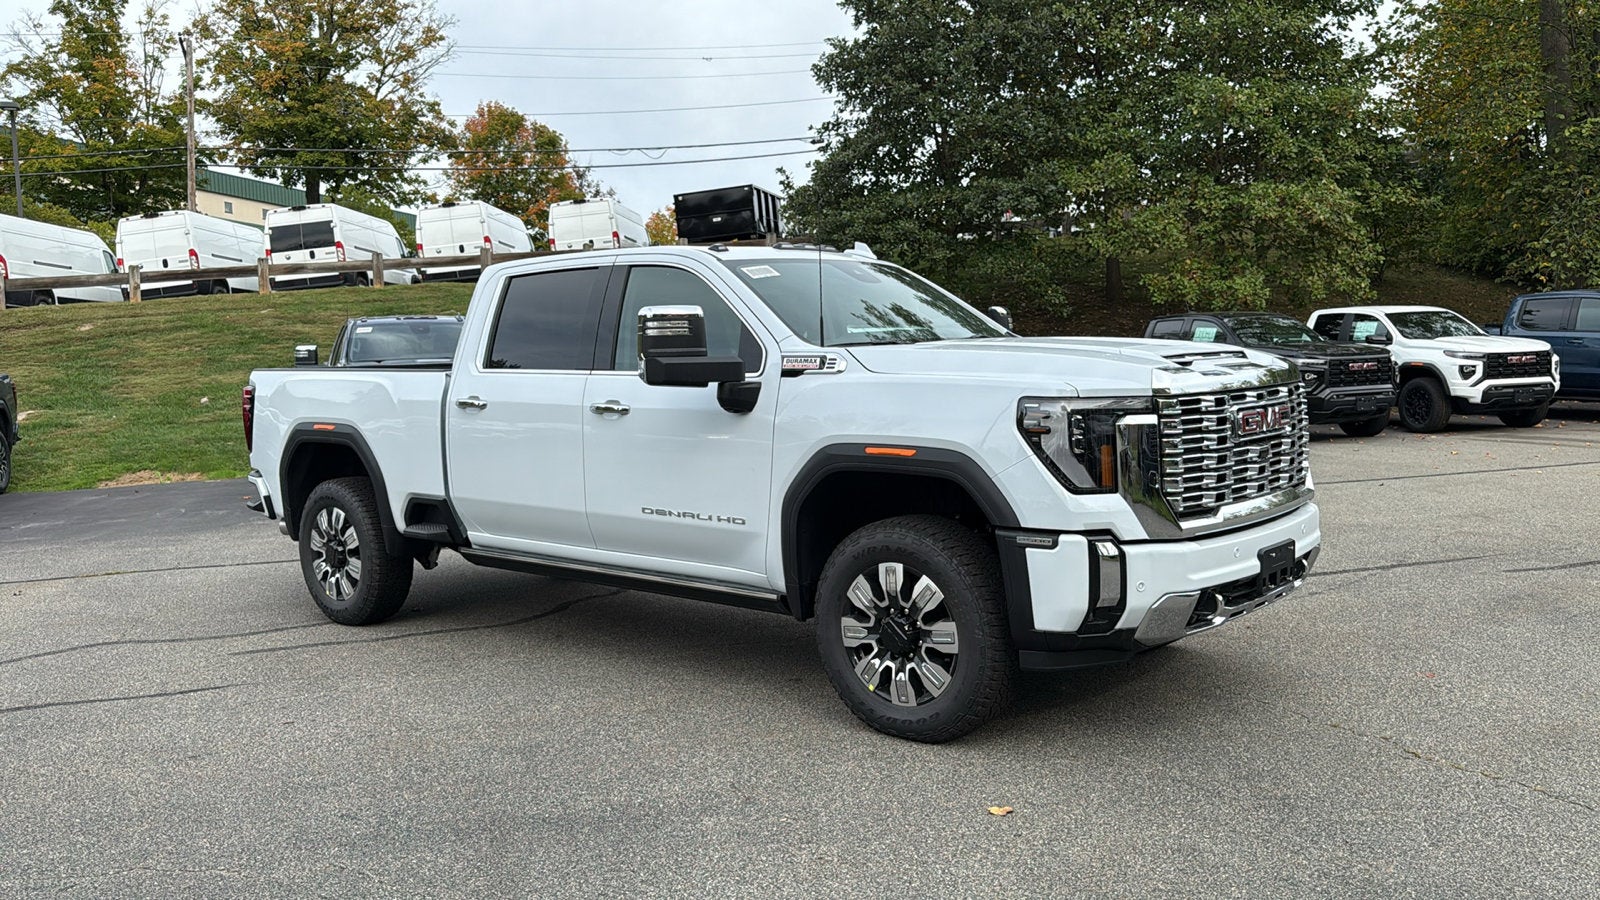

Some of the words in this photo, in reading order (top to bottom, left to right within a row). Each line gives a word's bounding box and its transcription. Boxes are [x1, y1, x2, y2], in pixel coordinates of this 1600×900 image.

[1240, 405, 1291, 433] GMC
[641, 507, 713, 522] DENALI
[716, 515, 746, 526] HD
